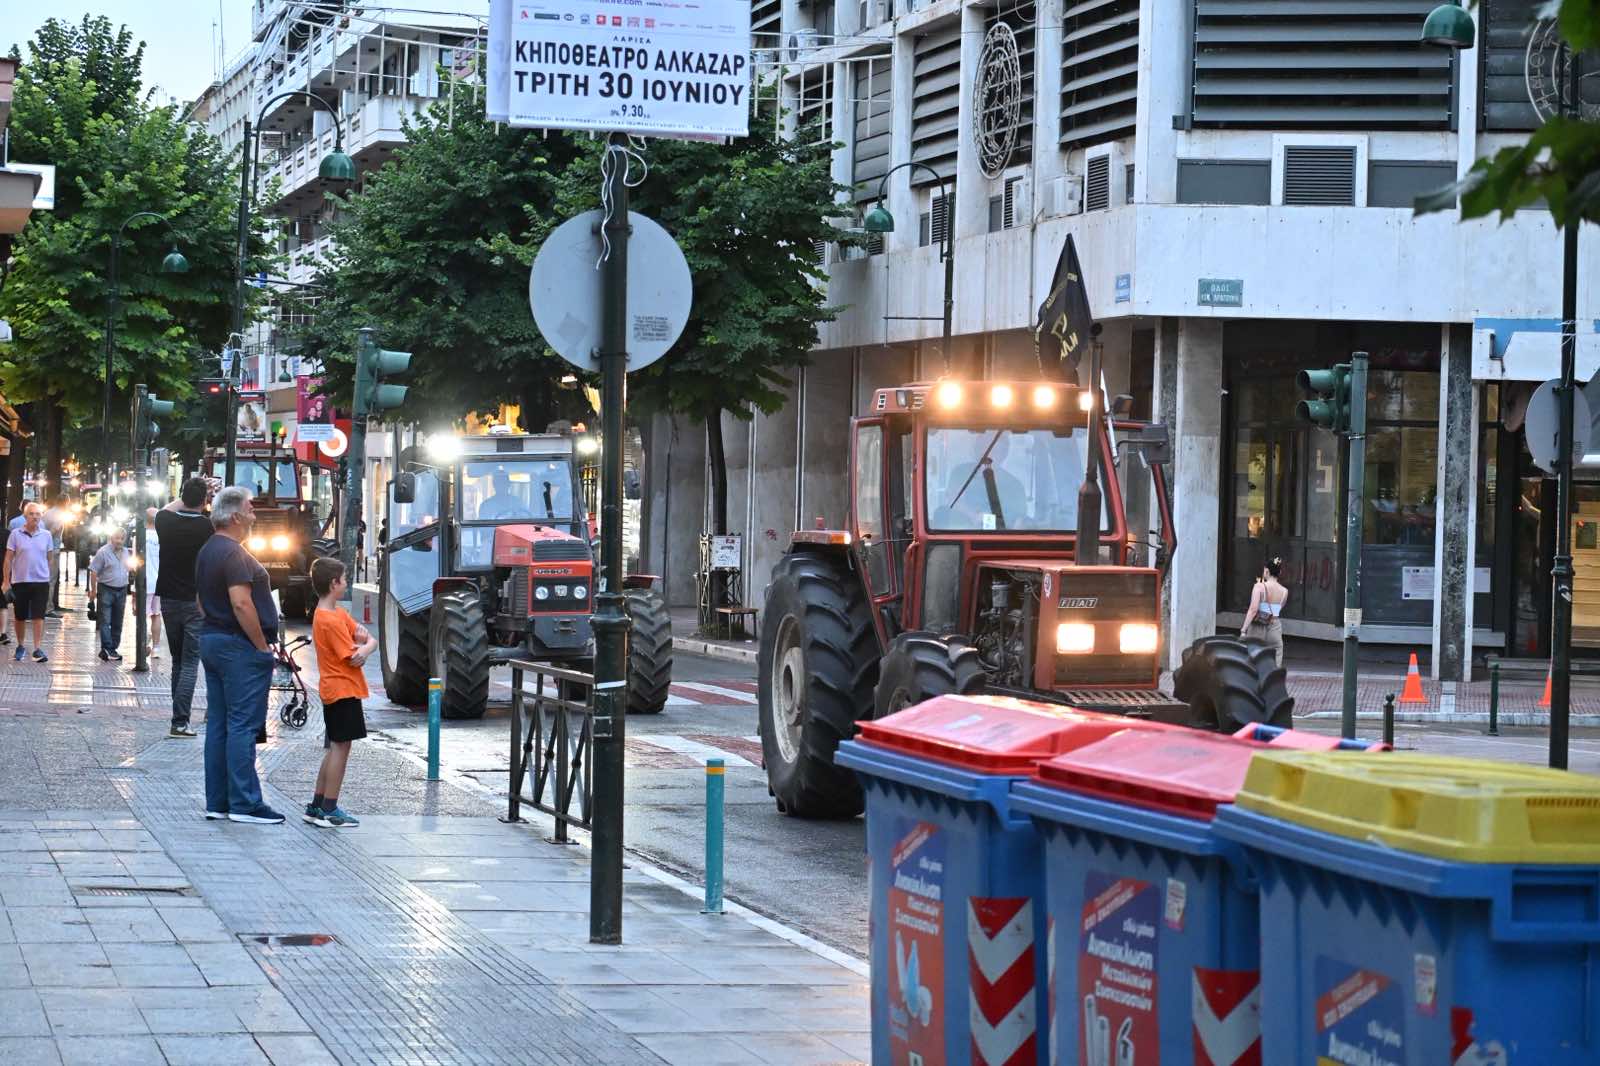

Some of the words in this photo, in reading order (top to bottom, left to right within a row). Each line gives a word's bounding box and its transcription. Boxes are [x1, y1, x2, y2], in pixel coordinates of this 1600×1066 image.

[612, 35, 652, 44] ΛΑΡΙΣΑ
[515, 40, 648, 70] ΚΗΠΟΘΕΑΤΡΟ
[654, 49, 745, 76] ΑΛΚΑΖΑΡ
[514, 70, 589, 97] ΤΡΙΤΗ
[598, 71, 633, 99] 30
[643, 78, 744, 106] ΙΟΥΝΙΟΥ
[1059, 598, 1096, 608] FIAT
[1087, 931, 1153, 971] Ανακύκλωση
